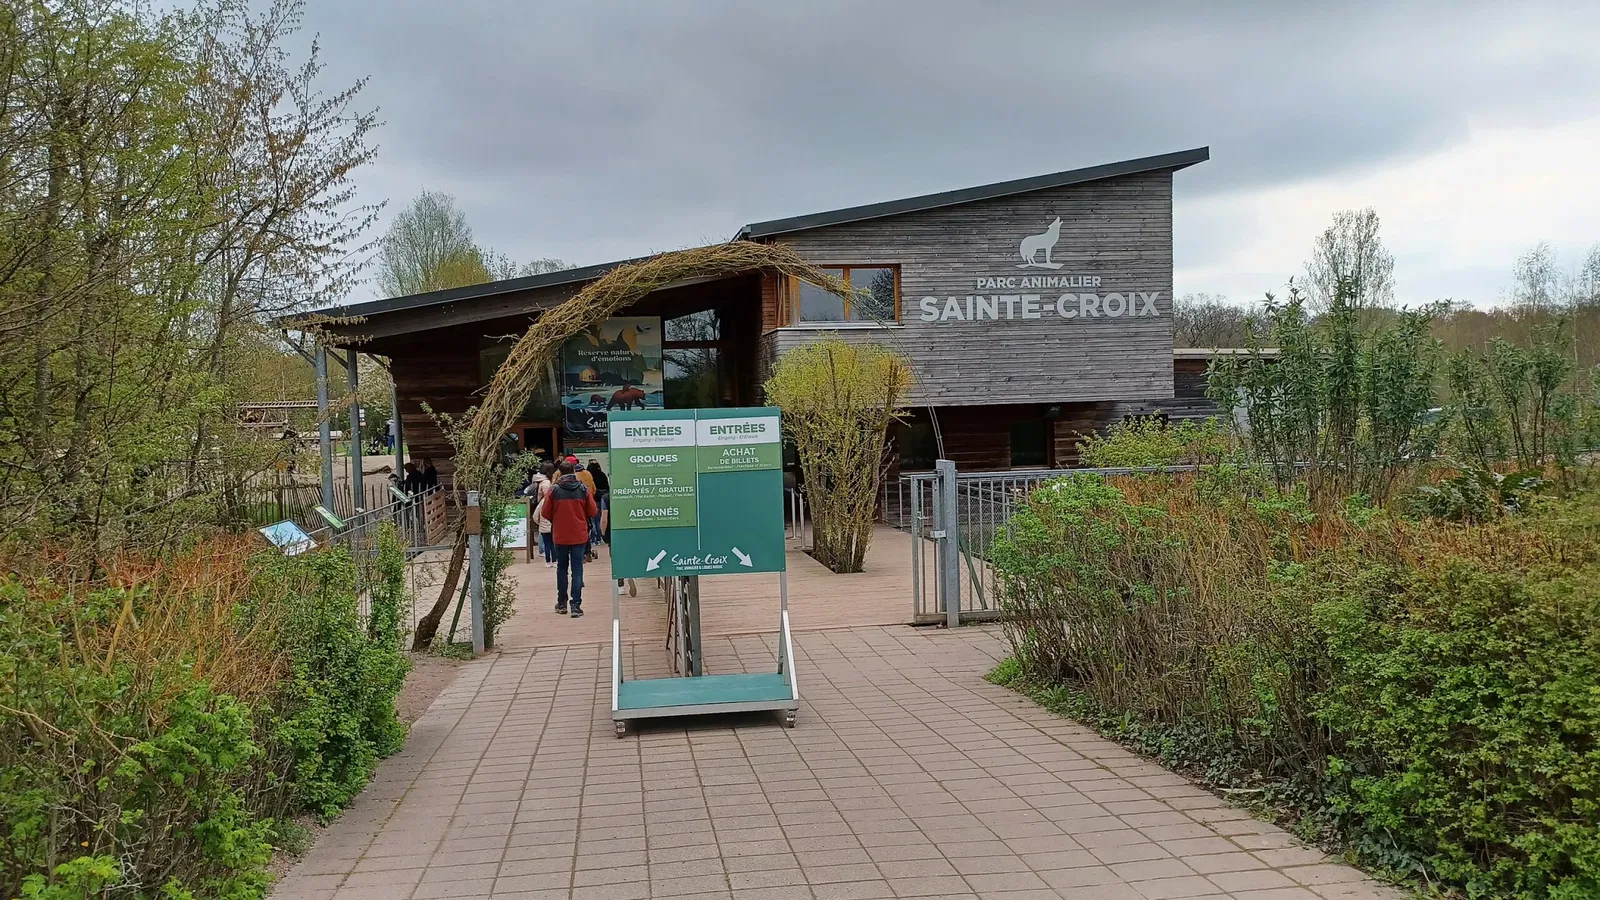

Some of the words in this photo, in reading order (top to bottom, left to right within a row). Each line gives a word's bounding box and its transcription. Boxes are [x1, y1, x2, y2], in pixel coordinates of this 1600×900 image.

[976, 277, 1016, 289] PARC
[1021, 275, 1102, 289] ANIMALIER
[919, 291, 1160, 322] SAINTE-CROIX
[624, 425, 682, 437] ENTRÉES
[709, 421, 766, 435] ENTRÉES
[722, 447, 756, 457] ACHAT
[629, 454, 678, 463] GROUPES
[731, 457, 760, 465] BILLETS
[632, 476, 674, 486] BILLETS
[613, 486, 650, 495] PRÉPAYÉS
[658, 485, 694, 494] GRATUITS
[629, 506, 679, 517] ABONNÉS
[671, 553, 728, 566] Sainte-Croix
